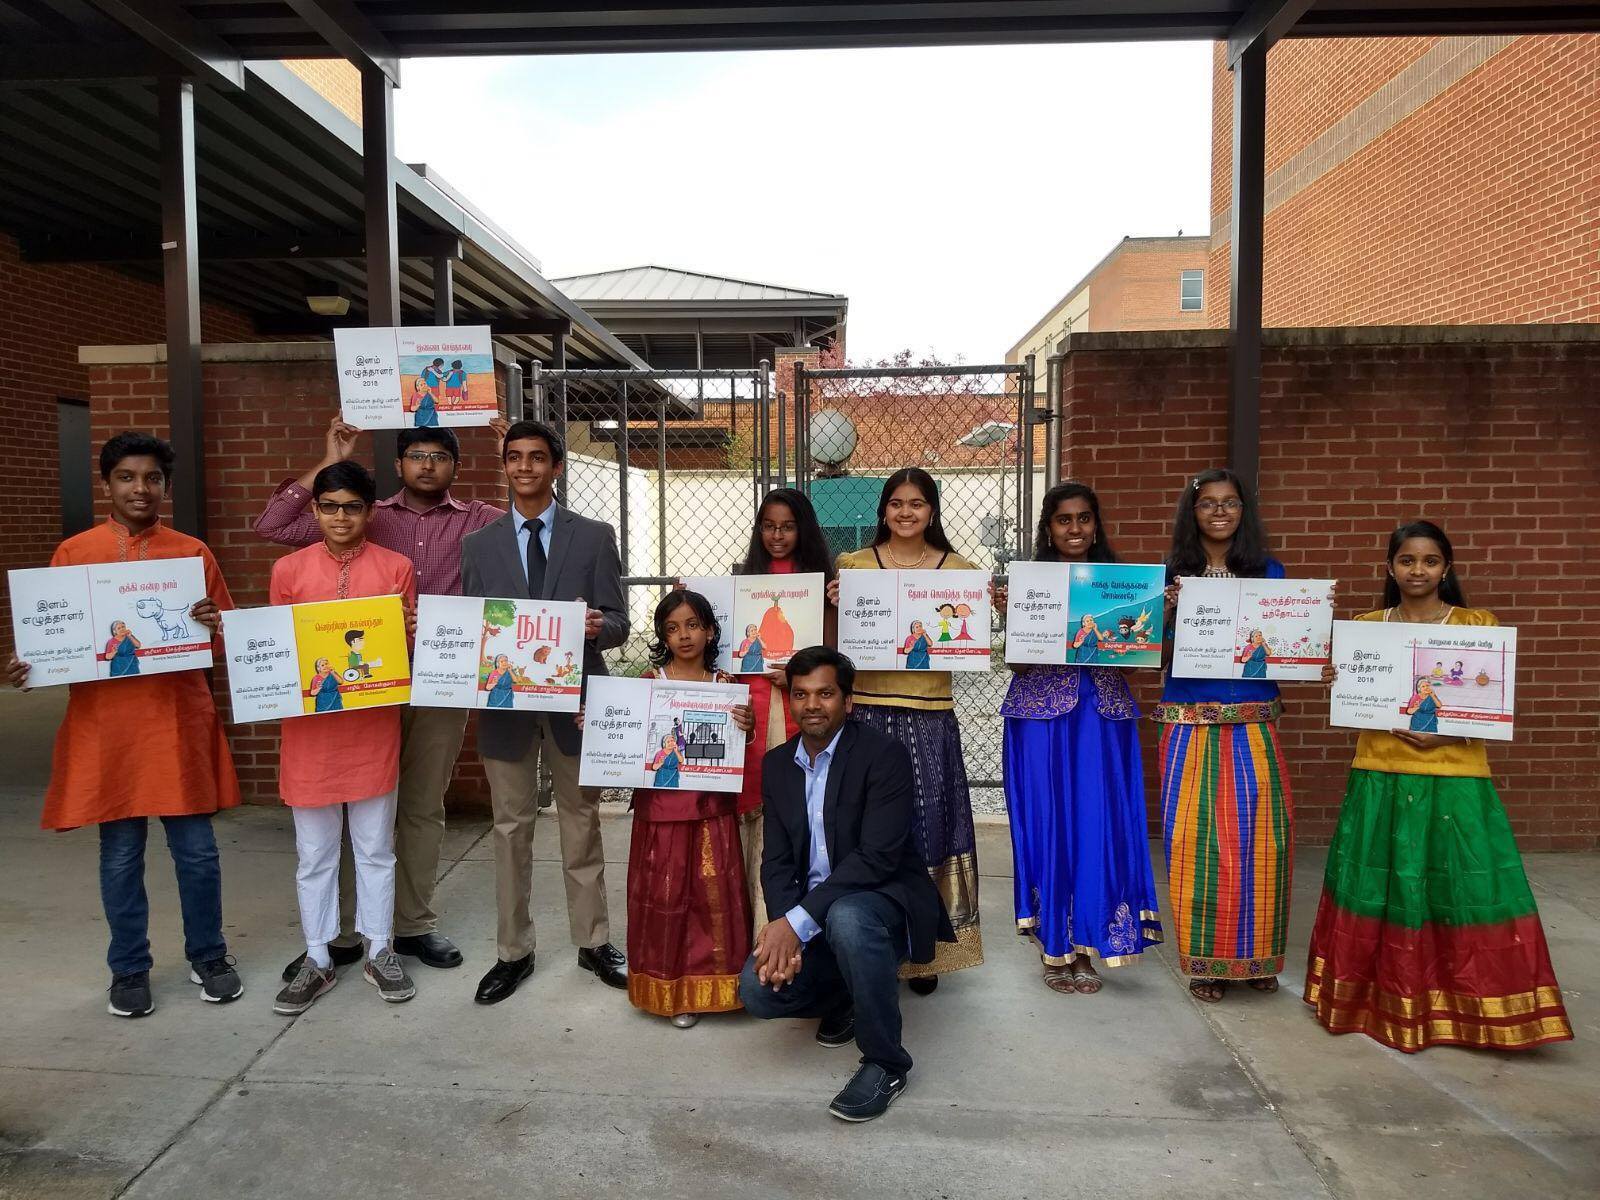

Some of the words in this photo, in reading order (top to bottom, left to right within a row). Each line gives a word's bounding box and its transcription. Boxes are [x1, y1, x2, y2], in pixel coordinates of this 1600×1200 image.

[356, 355, 380, 366] இளம்
[345, 368, 394, 378] எழுத்தாளர்
[1026, 589, 1050, 599] இளம்
[37, 599, 68, 612] இளம்
[857, 596, 880, 606] இளம்
[1014, 601, 1062, 612] எழுத்தாளர்
[845, 608, 892, 619] எழுத்தாளர்
[1196, 605, 1220, 615] இளம்
[22, 611, 85, 627] எழுத்தாளர்
[1183, 618, 1231, 628] எழுத்தாளர்
[45, 627, 65, 635] 2018
[437, 625, 463, 636] இளம்
[516, 608, 561, 649] நட்பு
[247, 638, 276, 650] இளம்
[422, 638, 475, 649] எழுத்தாளர்
[235, 649, 291, 664] எழுத்தாளர்
[1353, 650, 1380, 661] இளம்
[1339, 664, 1393, 673] எழுத்தாளர்
[605, 706, 630, 717] இளம்
[591, 719, 643, 730] எழுத்தாளர்
